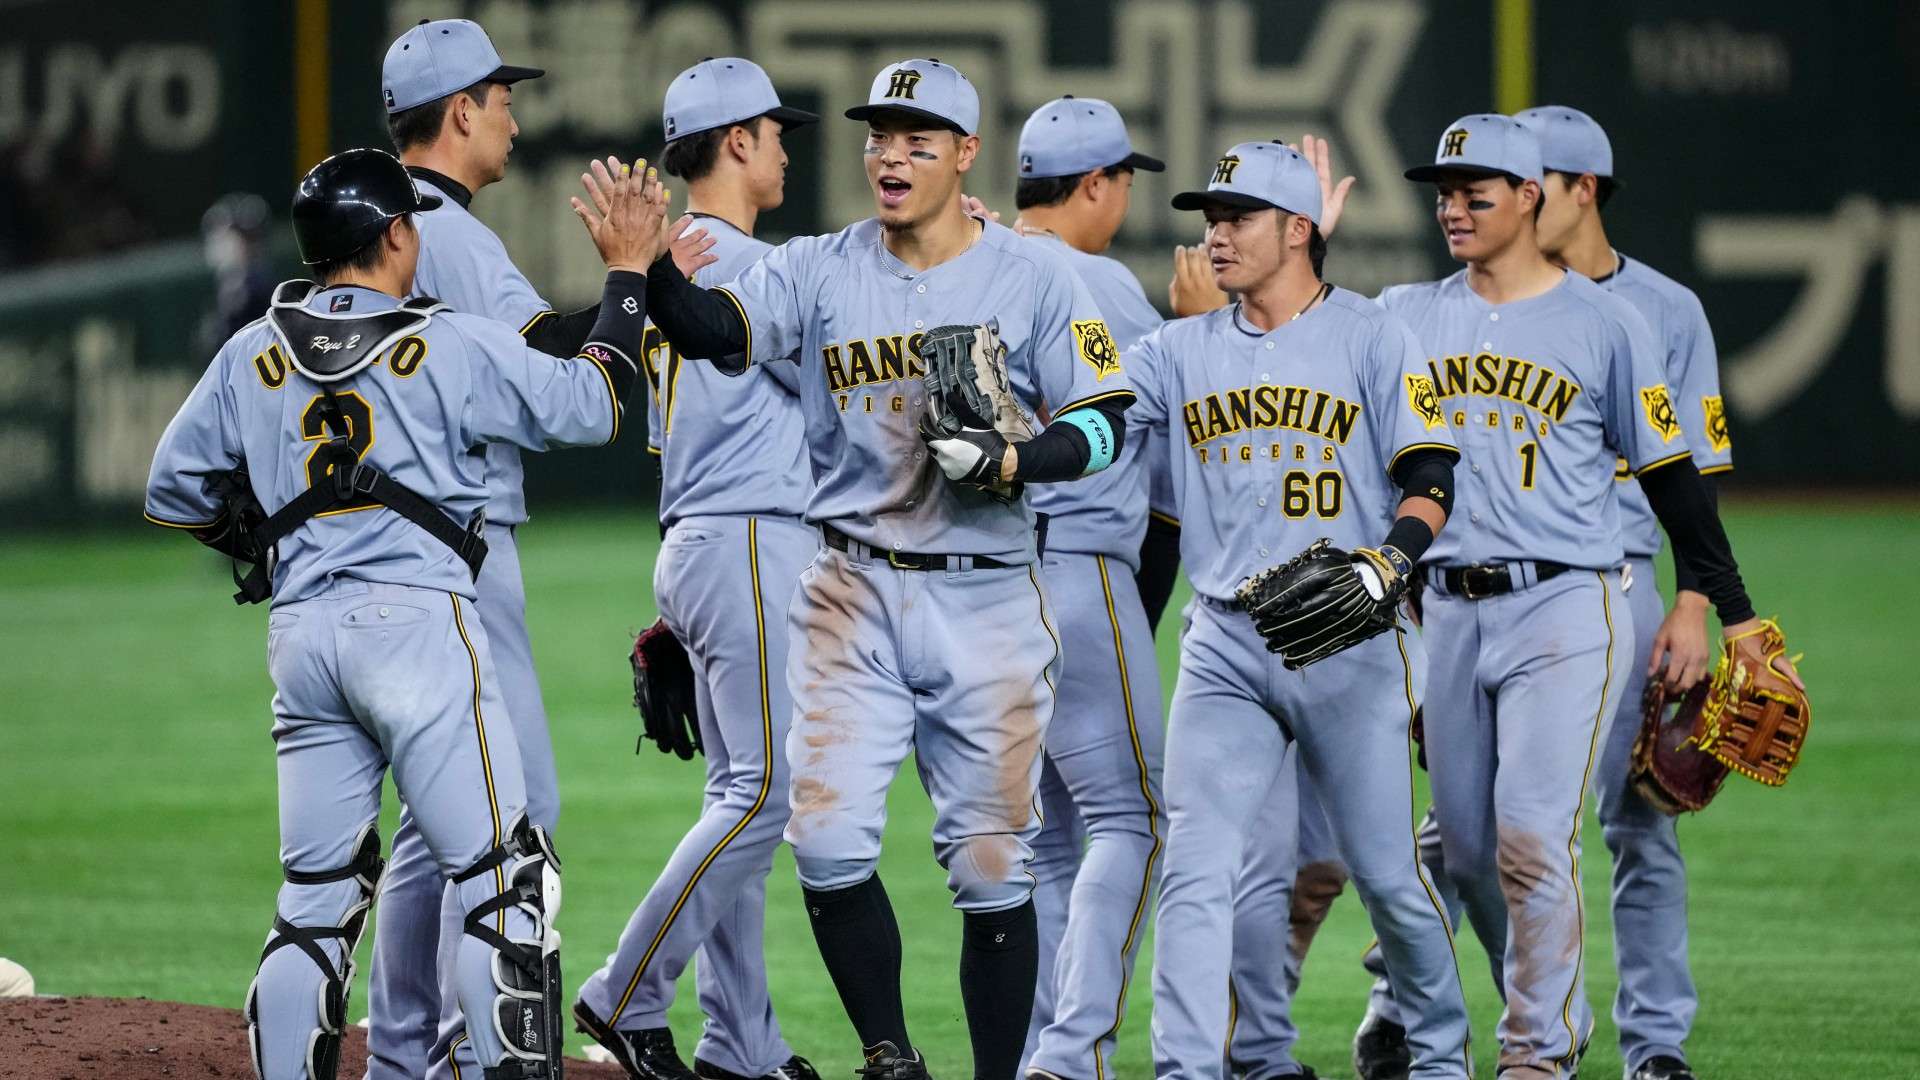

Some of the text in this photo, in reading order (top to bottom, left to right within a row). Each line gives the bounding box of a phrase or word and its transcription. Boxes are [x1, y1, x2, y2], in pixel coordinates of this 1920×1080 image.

[310, 334, 361, 353] Ryu 2
[821, 331, 926, 393] HANS
[839, 394, 905, 413] TIG
[1183, 383, 1362, 447] HANSHIN
[1454, 411, 1549, 437] GERS
[1200, 443, 1335, 464] TIGERS
[1517, 441, 1537, 491] 1
[1282, 468, 1344, 521] 60
